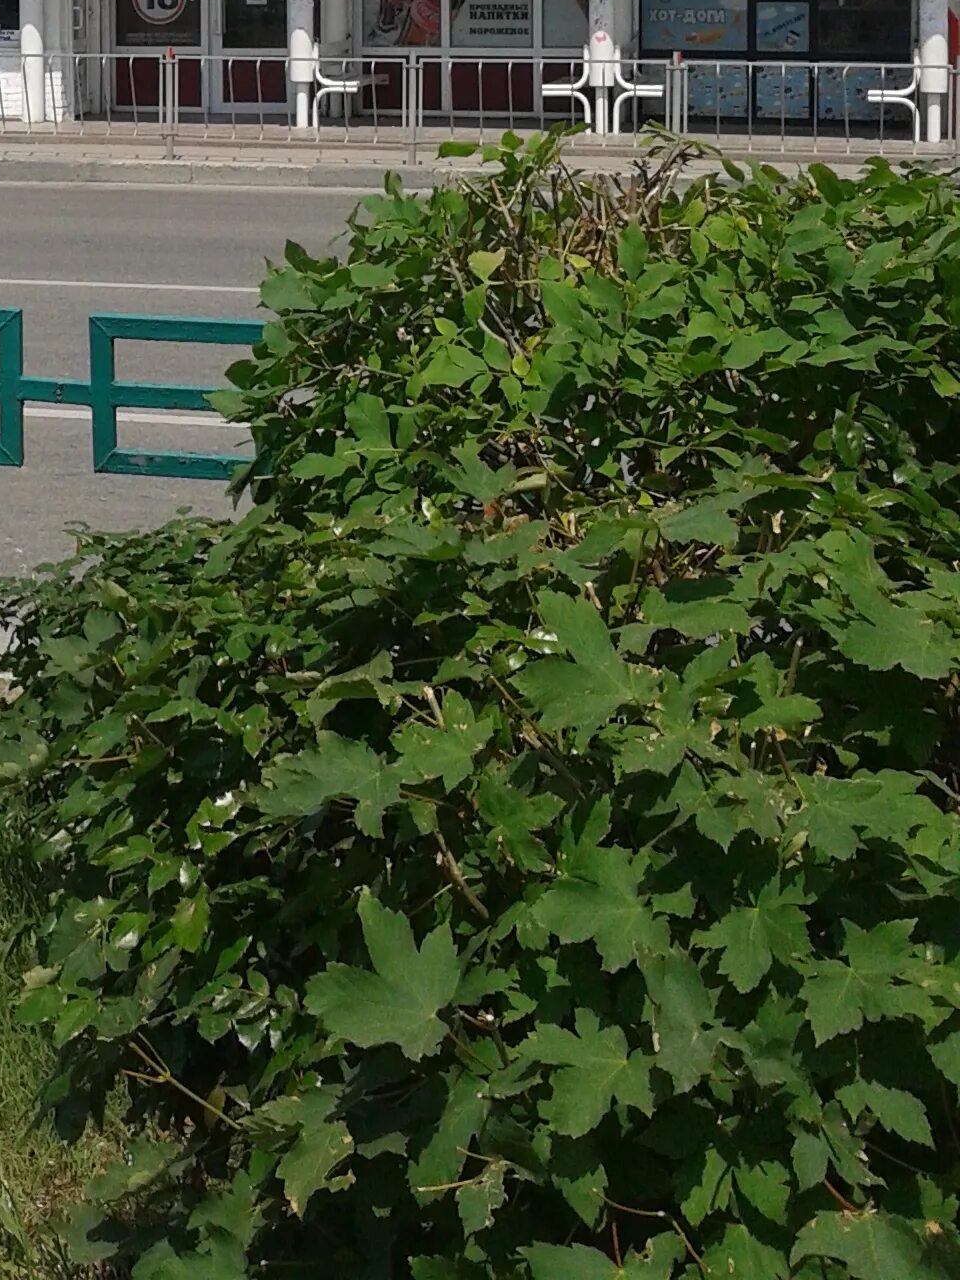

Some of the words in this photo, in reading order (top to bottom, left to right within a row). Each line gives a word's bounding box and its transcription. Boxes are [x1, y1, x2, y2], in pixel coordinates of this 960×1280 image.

[469, 11, 529, 21] НАПИТКИ
[648, 9, 725, 24] ХОТ-ДОГИ
[469, 27, 530, 36] МОРОЖЕНОЕ
